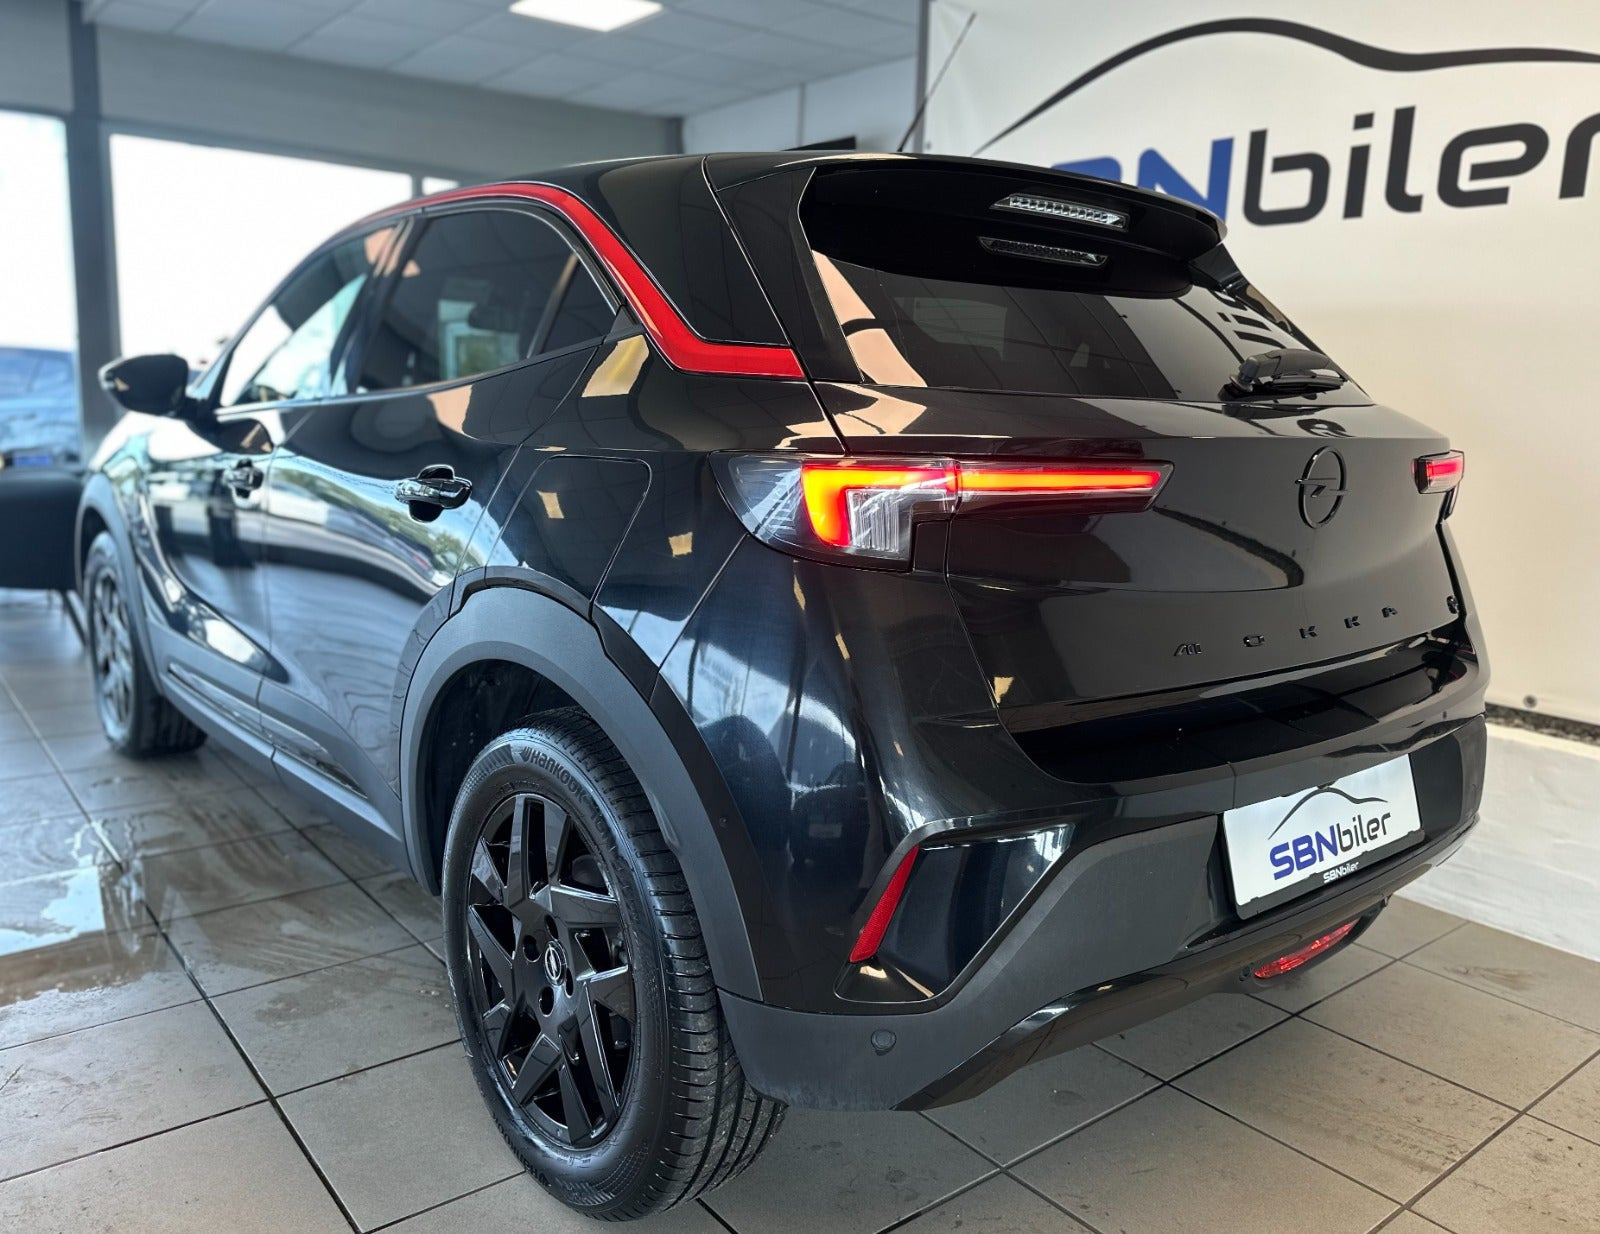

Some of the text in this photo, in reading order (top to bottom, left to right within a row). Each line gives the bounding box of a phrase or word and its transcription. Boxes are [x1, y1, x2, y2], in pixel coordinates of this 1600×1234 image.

[1050, 105, 1600, 227] Nbiler
[1269, 812, 1391, 881] SBNbiler
[1323, 861, 1359, 884] SBNbiler
